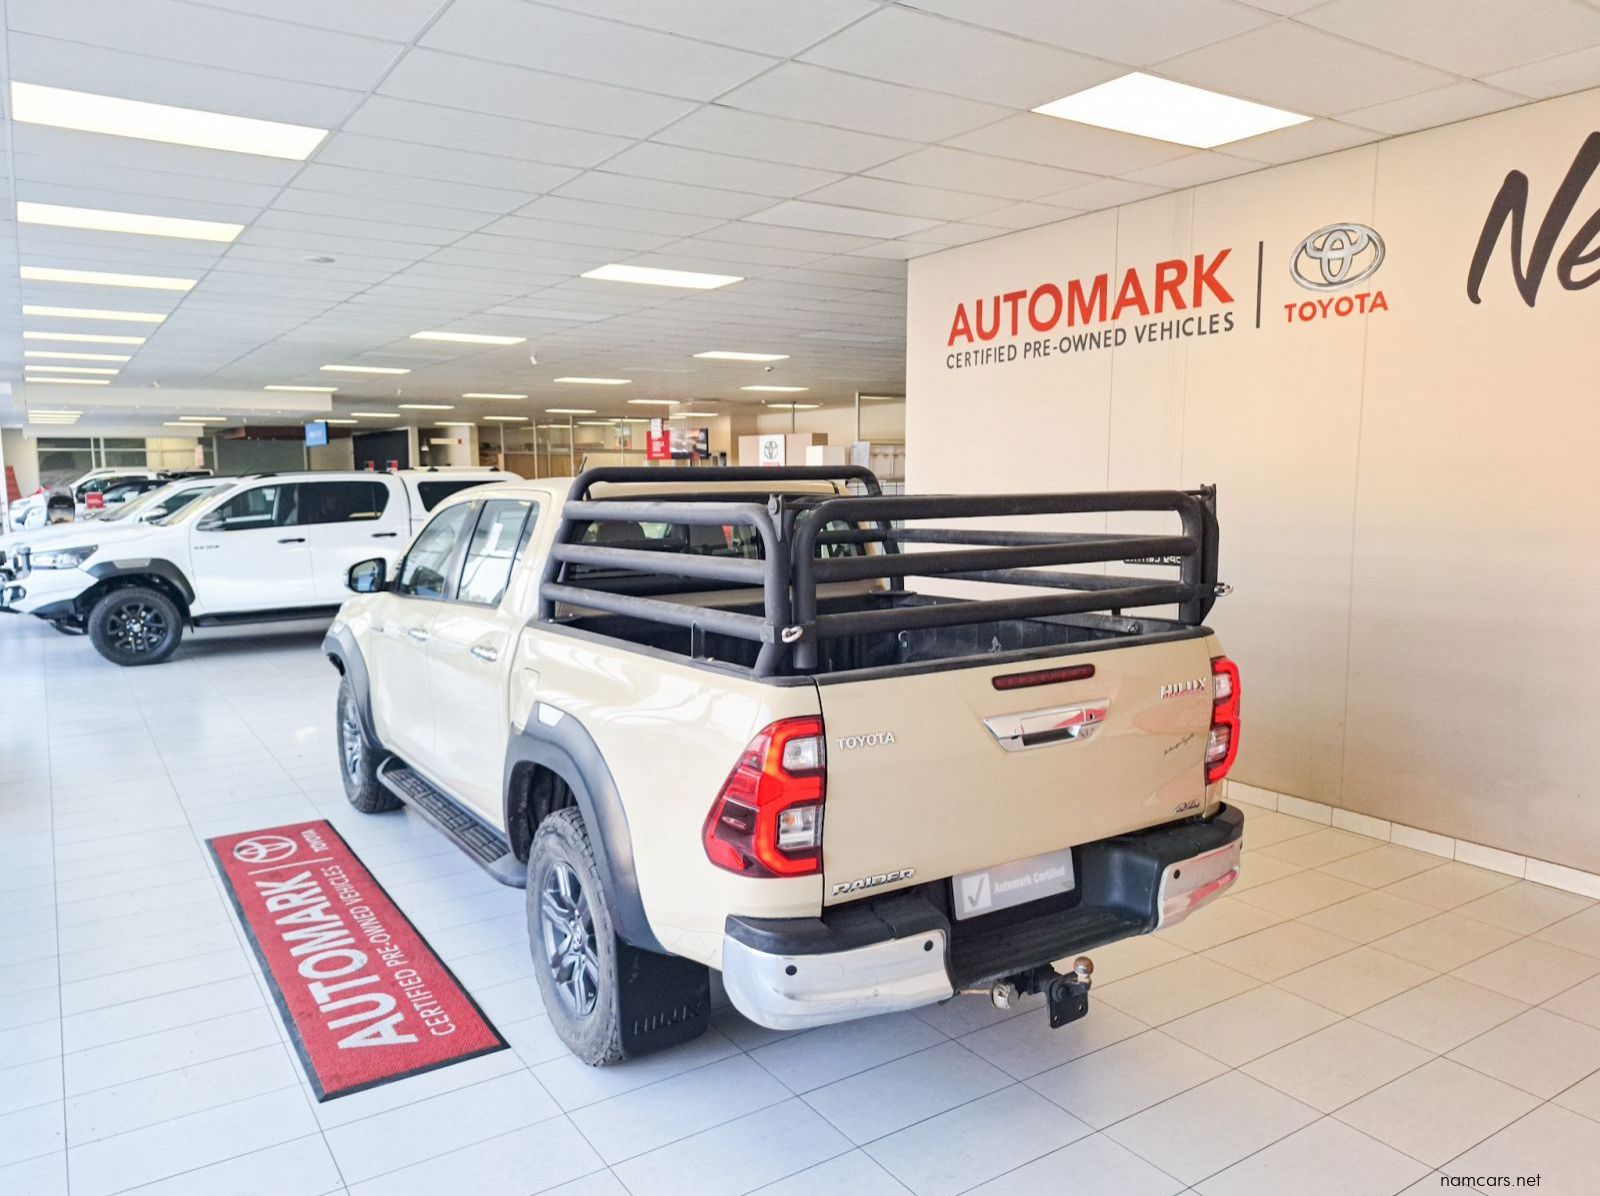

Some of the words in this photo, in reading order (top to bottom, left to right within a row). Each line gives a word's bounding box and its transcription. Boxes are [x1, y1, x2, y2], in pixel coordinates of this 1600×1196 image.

[948, 248, 1234, 346] AUTOMARK
[1285, 291, 1389, 324] TOYOTA
[946, 344, 1017, 369] CERTIFIED
[1023, 328, 1126, 359] PRE-OWNED
[1135, 312, 1234, 344] VEHICLES
[1160, 677, 1207, 700] HILUX
[836, 731, 895, 750] TOYOTA
[301, 828, 329, 853] TOYOTA
[320, 865, 364, 906] VEHICLES
[831, 868, 915, 895] RAIDER
[350, 904, 408, 968] PRE-OWNED
[255, 870, 418, 1050] AUTOMARK
[394, 967, 456, 1036] CERTIFIED
